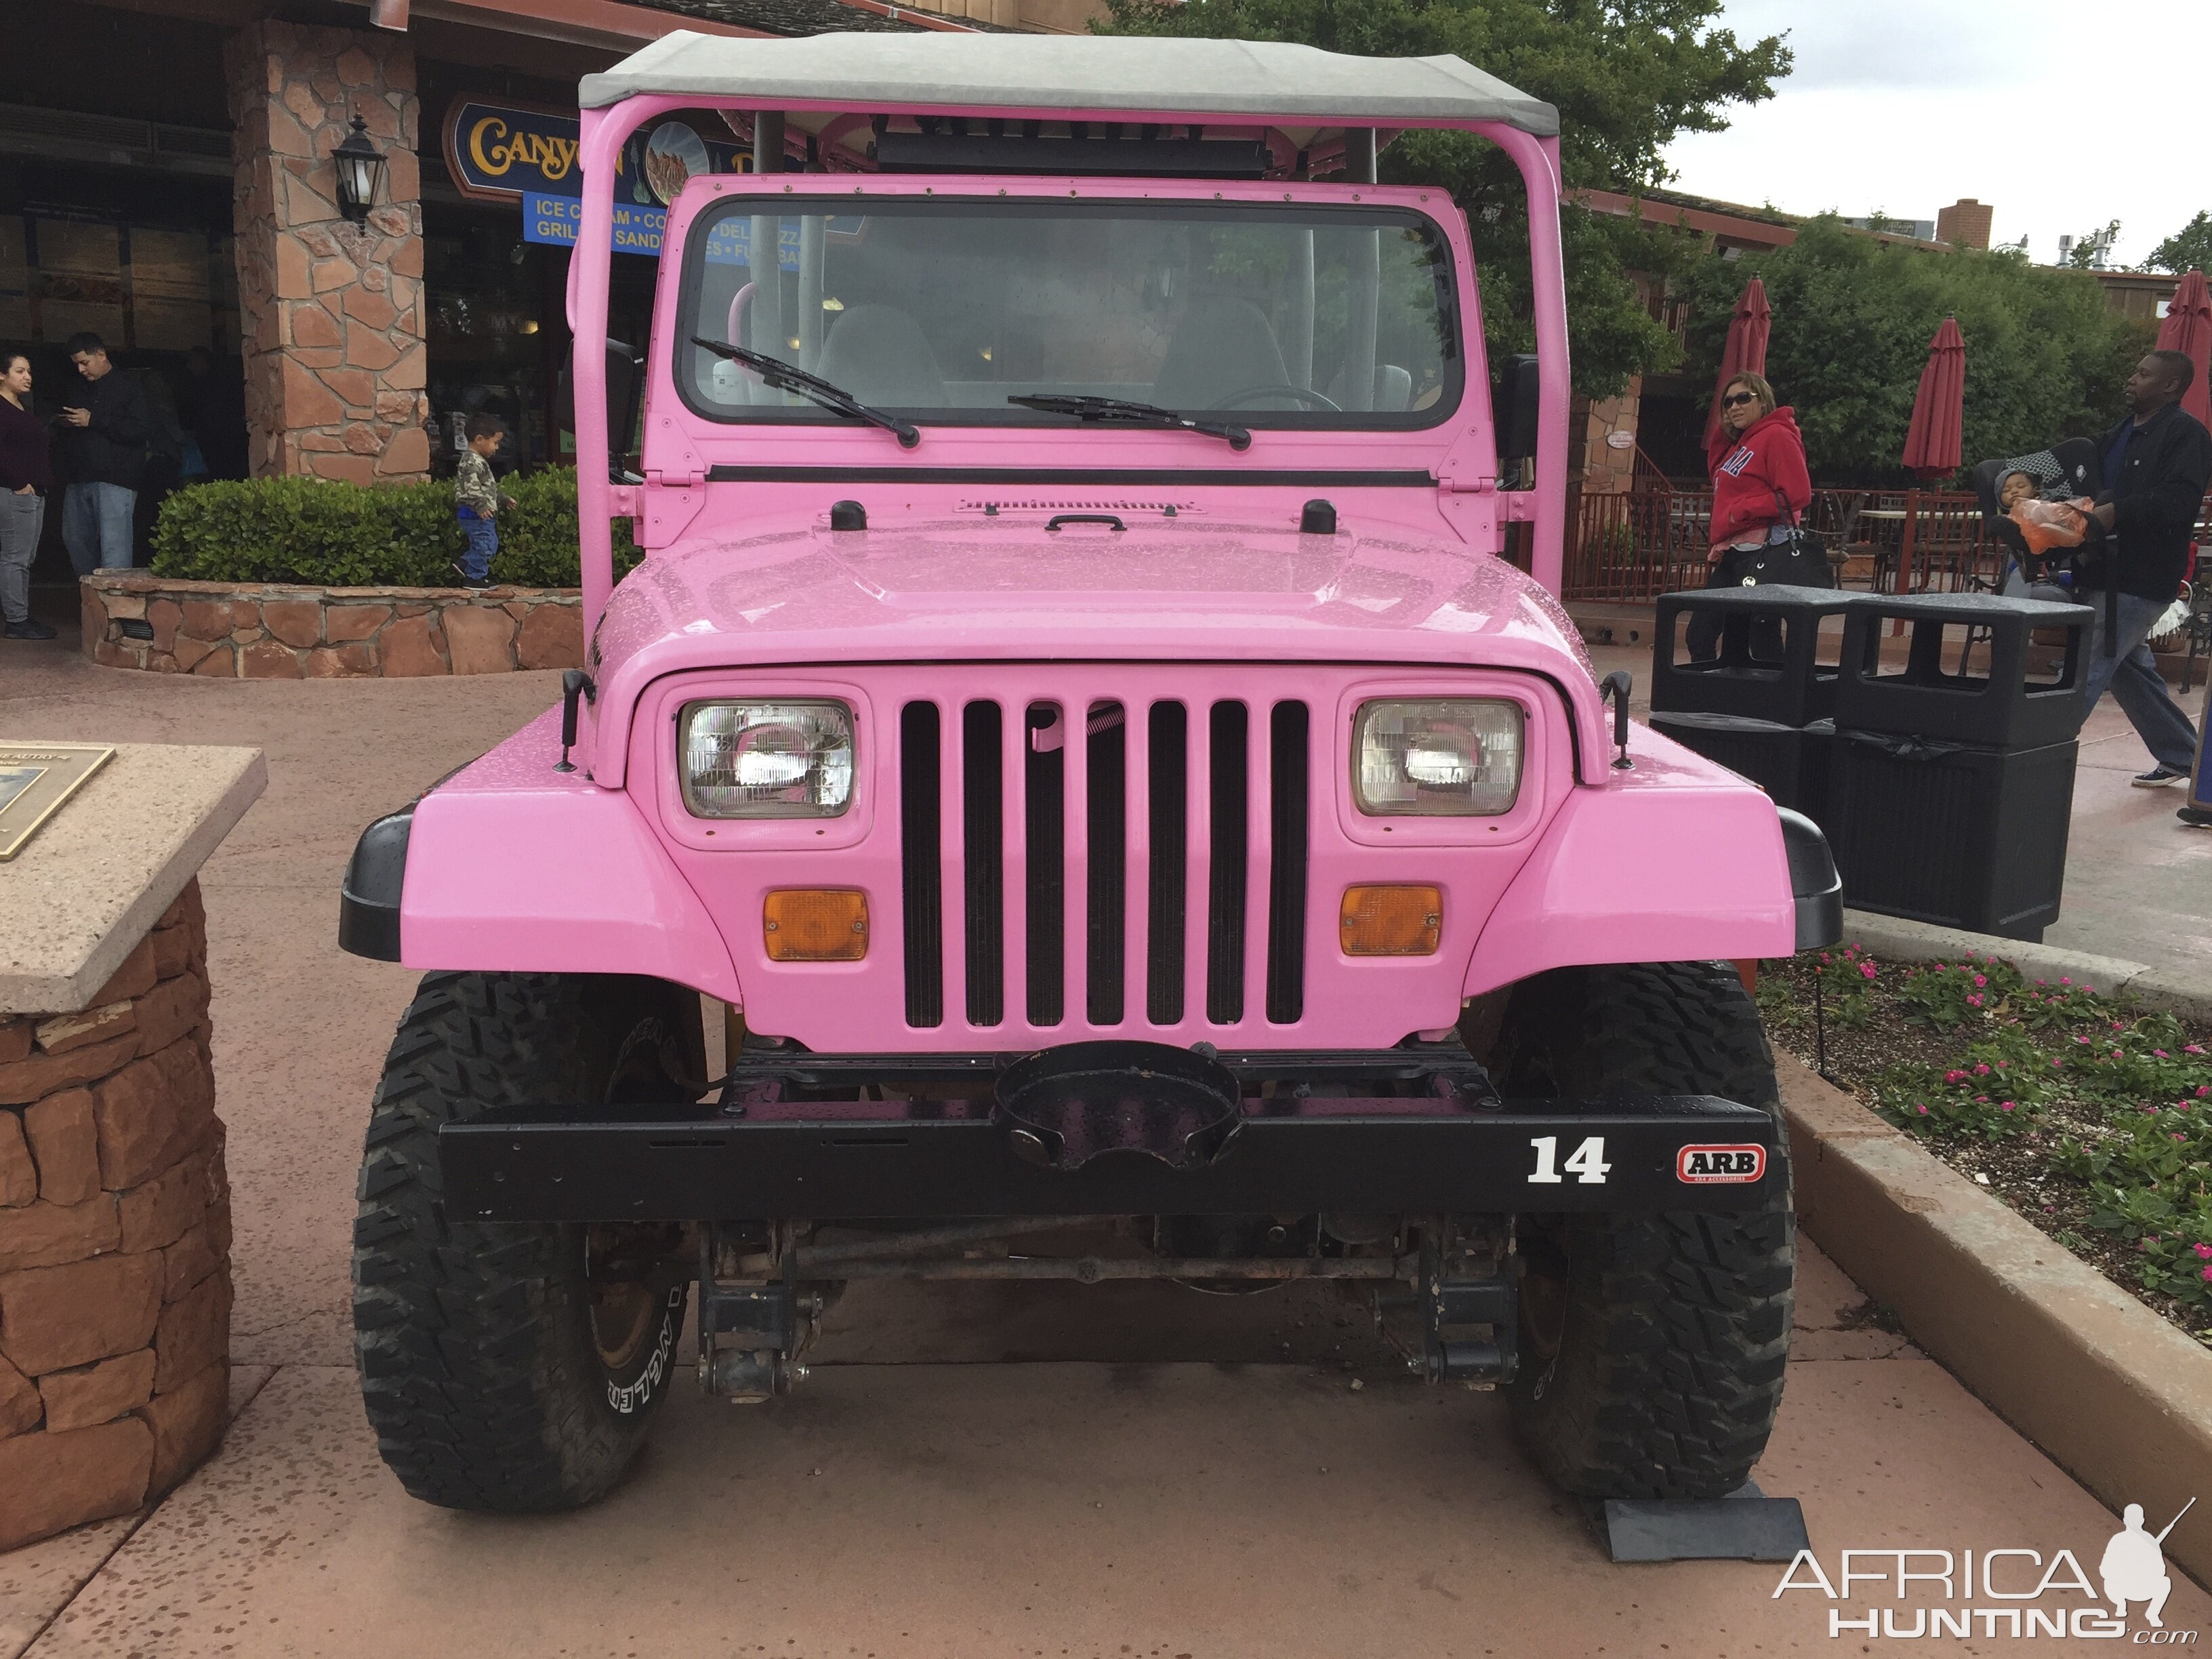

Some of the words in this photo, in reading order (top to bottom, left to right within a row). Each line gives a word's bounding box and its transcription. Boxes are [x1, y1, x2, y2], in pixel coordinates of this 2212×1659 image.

[537, 200, 564, 218] ICE
[720, 224, 750, 240] DEL
[1528, 1136, 1612, 1183] 14
[1687, 1153, 1756, 1174] ARB
